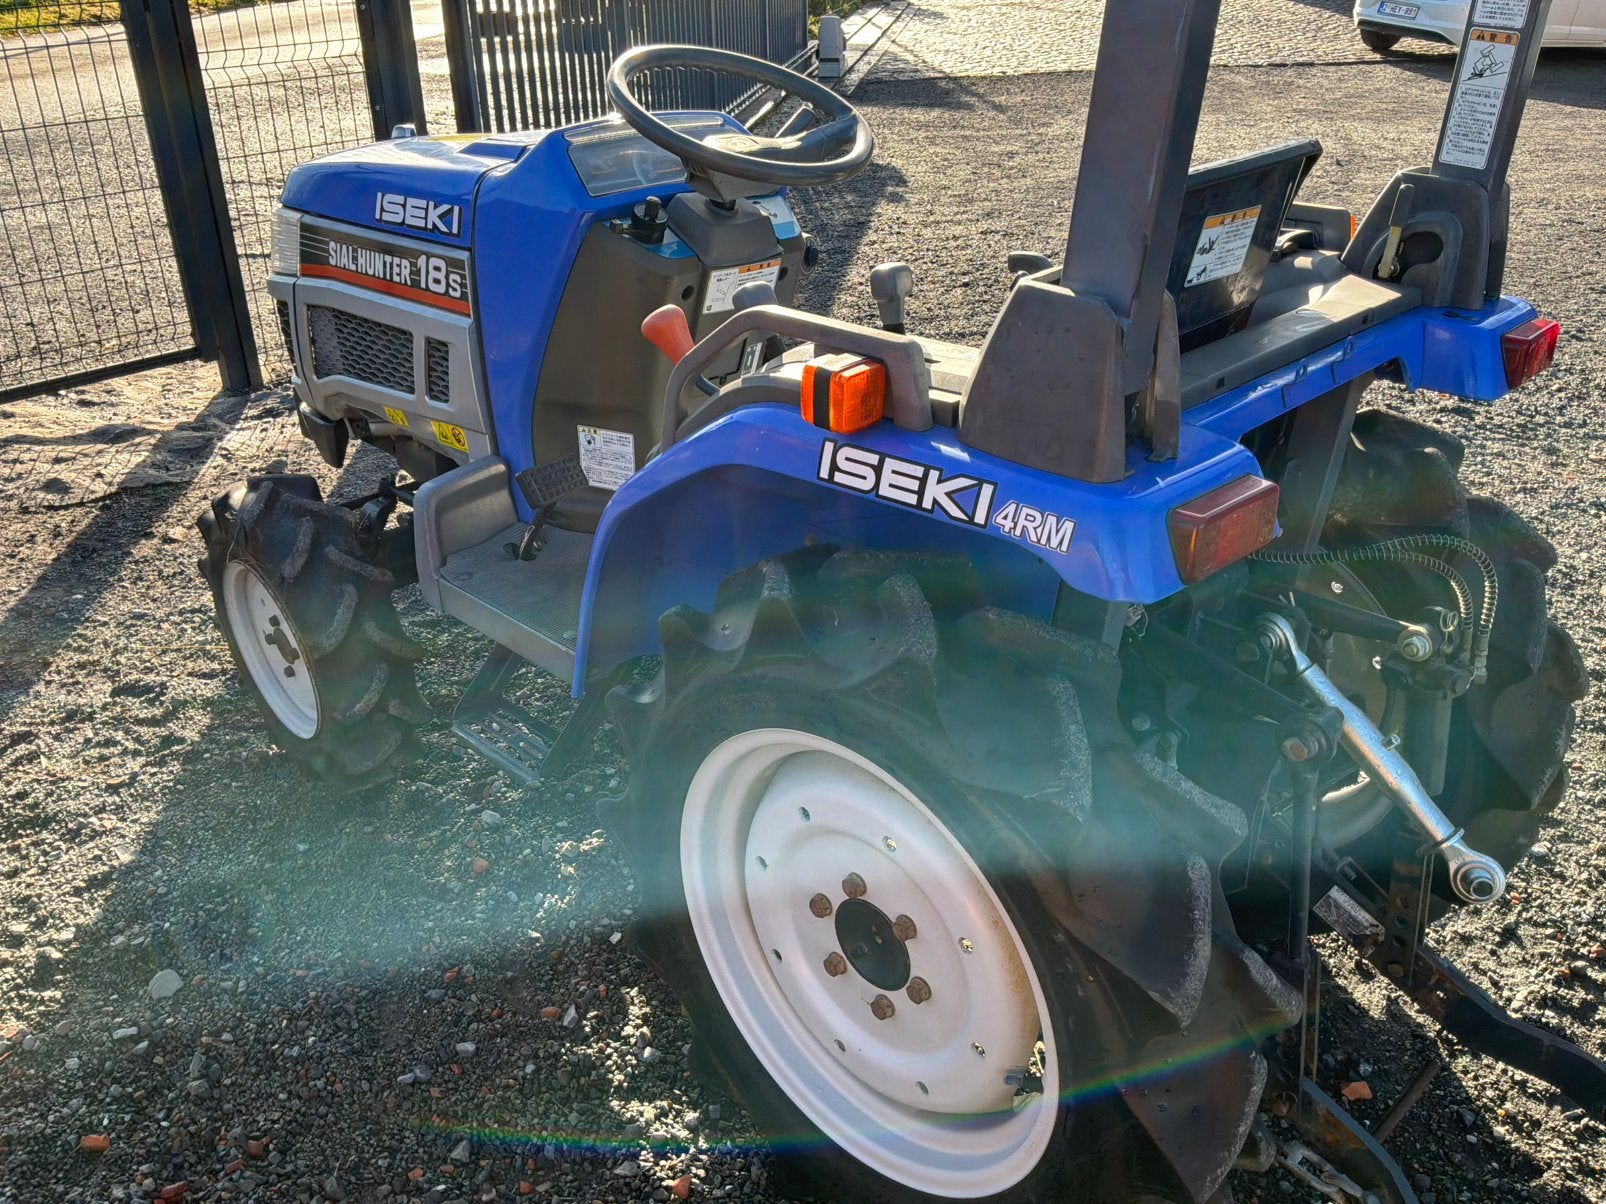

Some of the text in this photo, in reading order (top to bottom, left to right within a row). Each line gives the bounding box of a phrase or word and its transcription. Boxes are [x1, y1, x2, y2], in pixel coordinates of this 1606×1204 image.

[375, 192, 460, 235] ISEKI
[818, 439, 1075, 553] ISEKI 4RM
